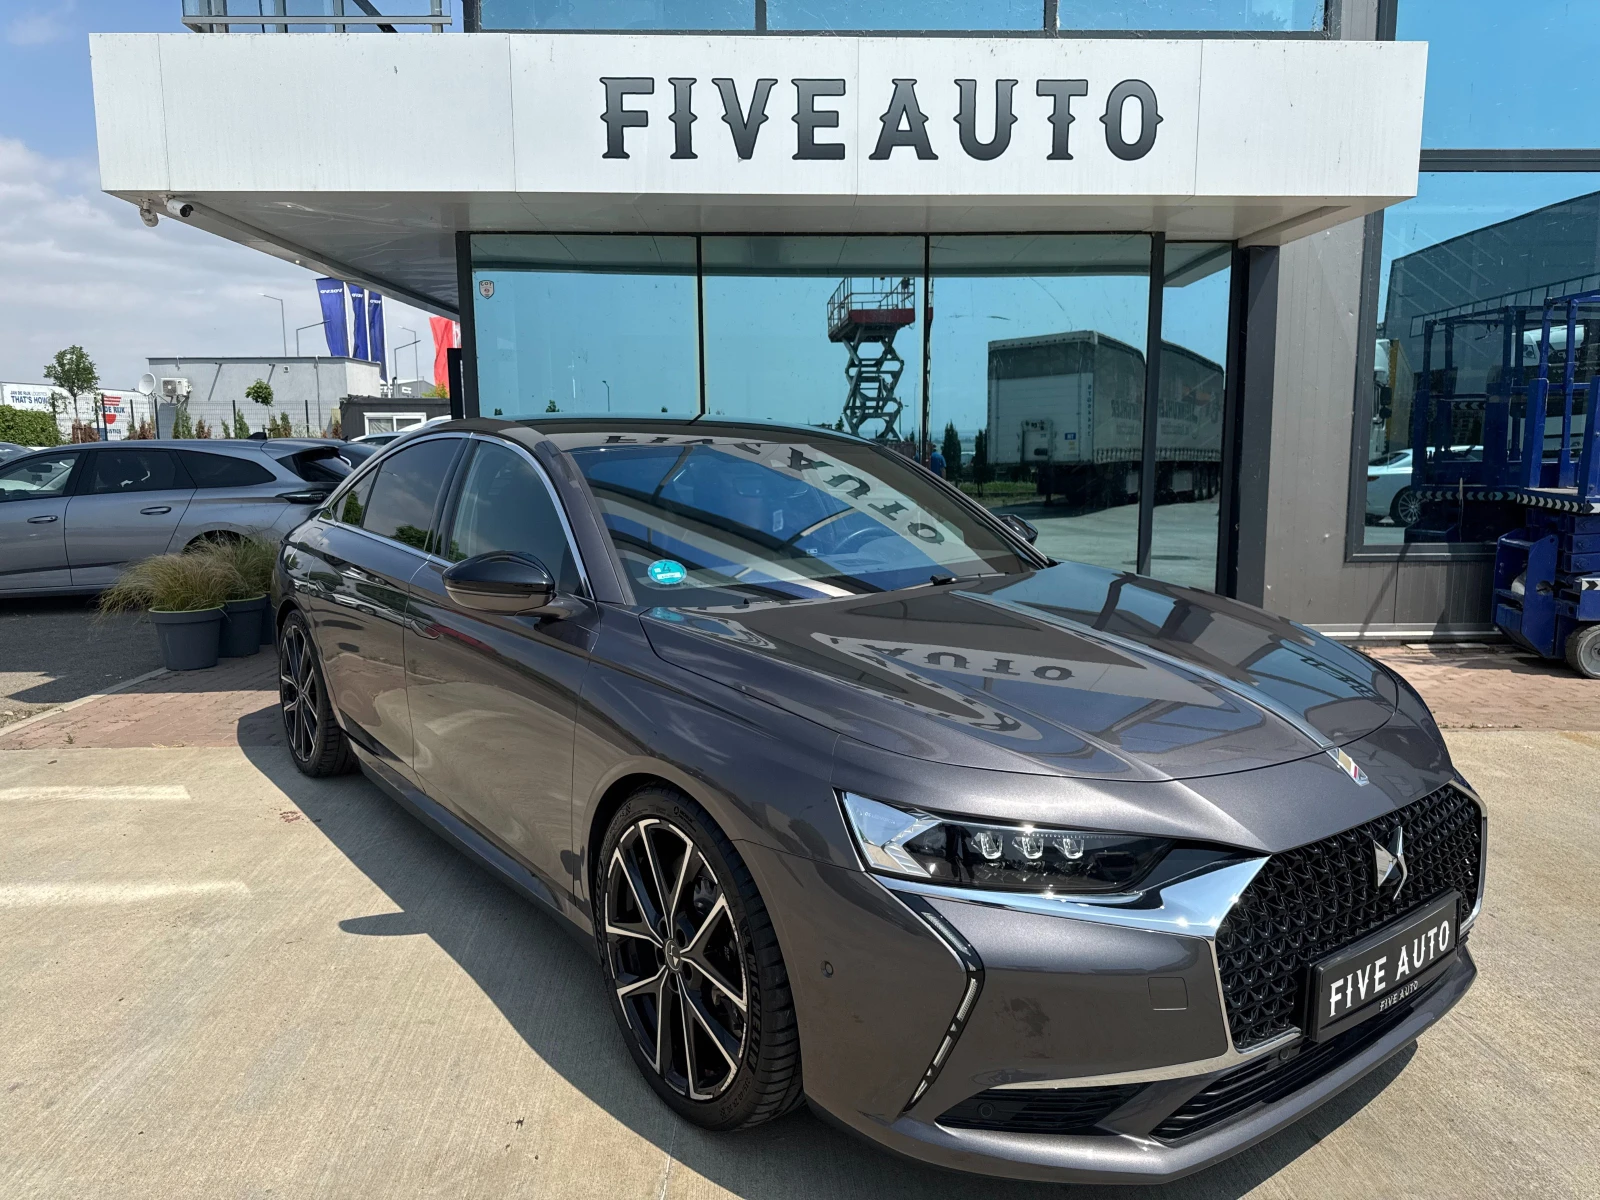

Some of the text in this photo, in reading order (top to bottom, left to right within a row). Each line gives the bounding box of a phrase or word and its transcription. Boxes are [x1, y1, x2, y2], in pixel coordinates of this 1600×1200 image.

[11, 396, 32, 404] THAT'S
[1329, 920, 1450, 1018] FIVE AUTO
[1380, 980, 1419, 1012] FIVE AUTO
[745, 951, 763, 1075] MICHELIN
